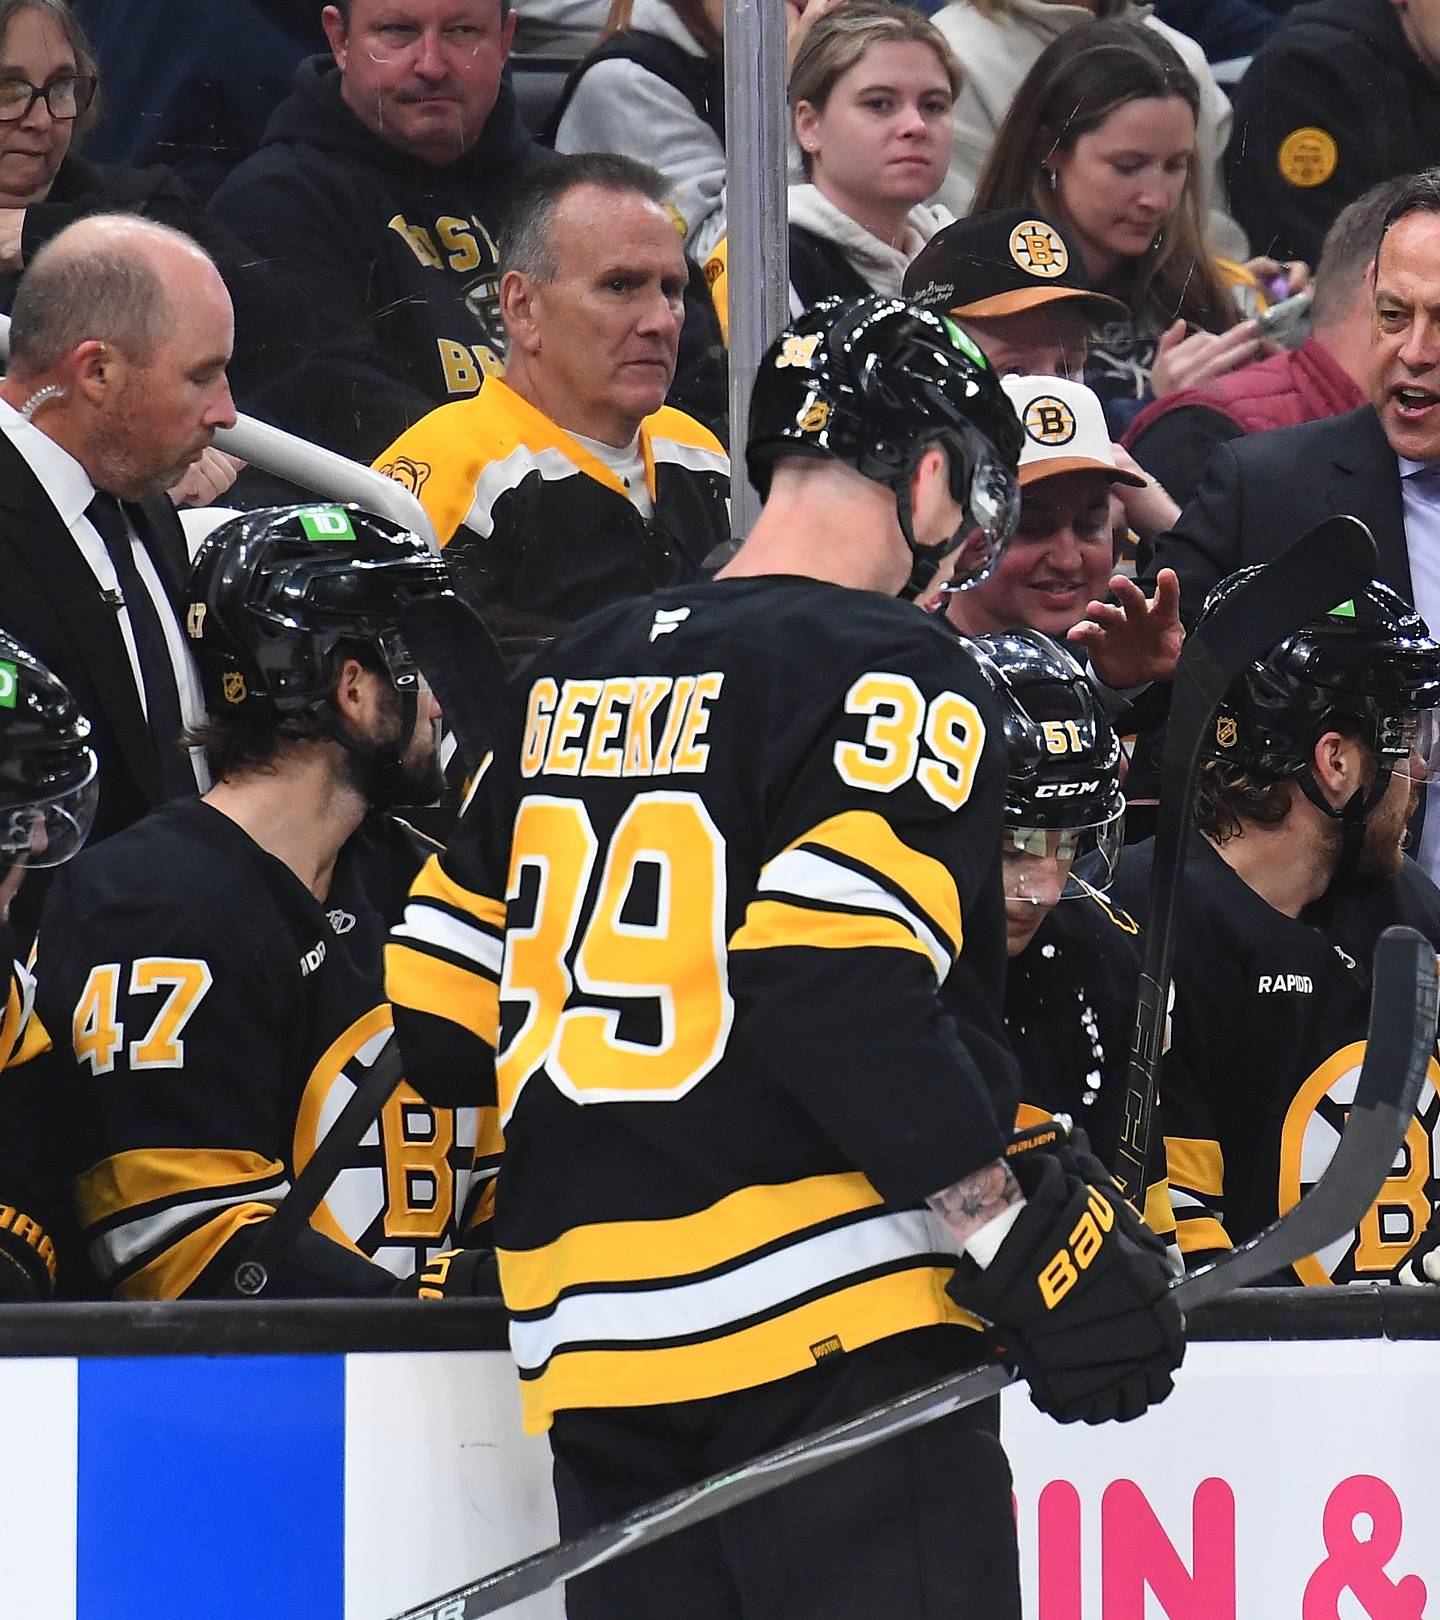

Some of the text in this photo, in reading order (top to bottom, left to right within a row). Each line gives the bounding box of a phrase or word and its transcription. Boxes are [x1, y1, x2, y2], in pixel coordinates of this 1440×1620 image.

[520, 672, 726, 779] GEEKIE
[833, 671, 986, 812] 39
[1041, 720, 1083, 754] 51
[1034, 780, 1100, 798] CCM
[72, 956, 213, 1076] 47
[497, 790, 736, 1131] 39
[1013, 1474, 1428, 1620] IN &
